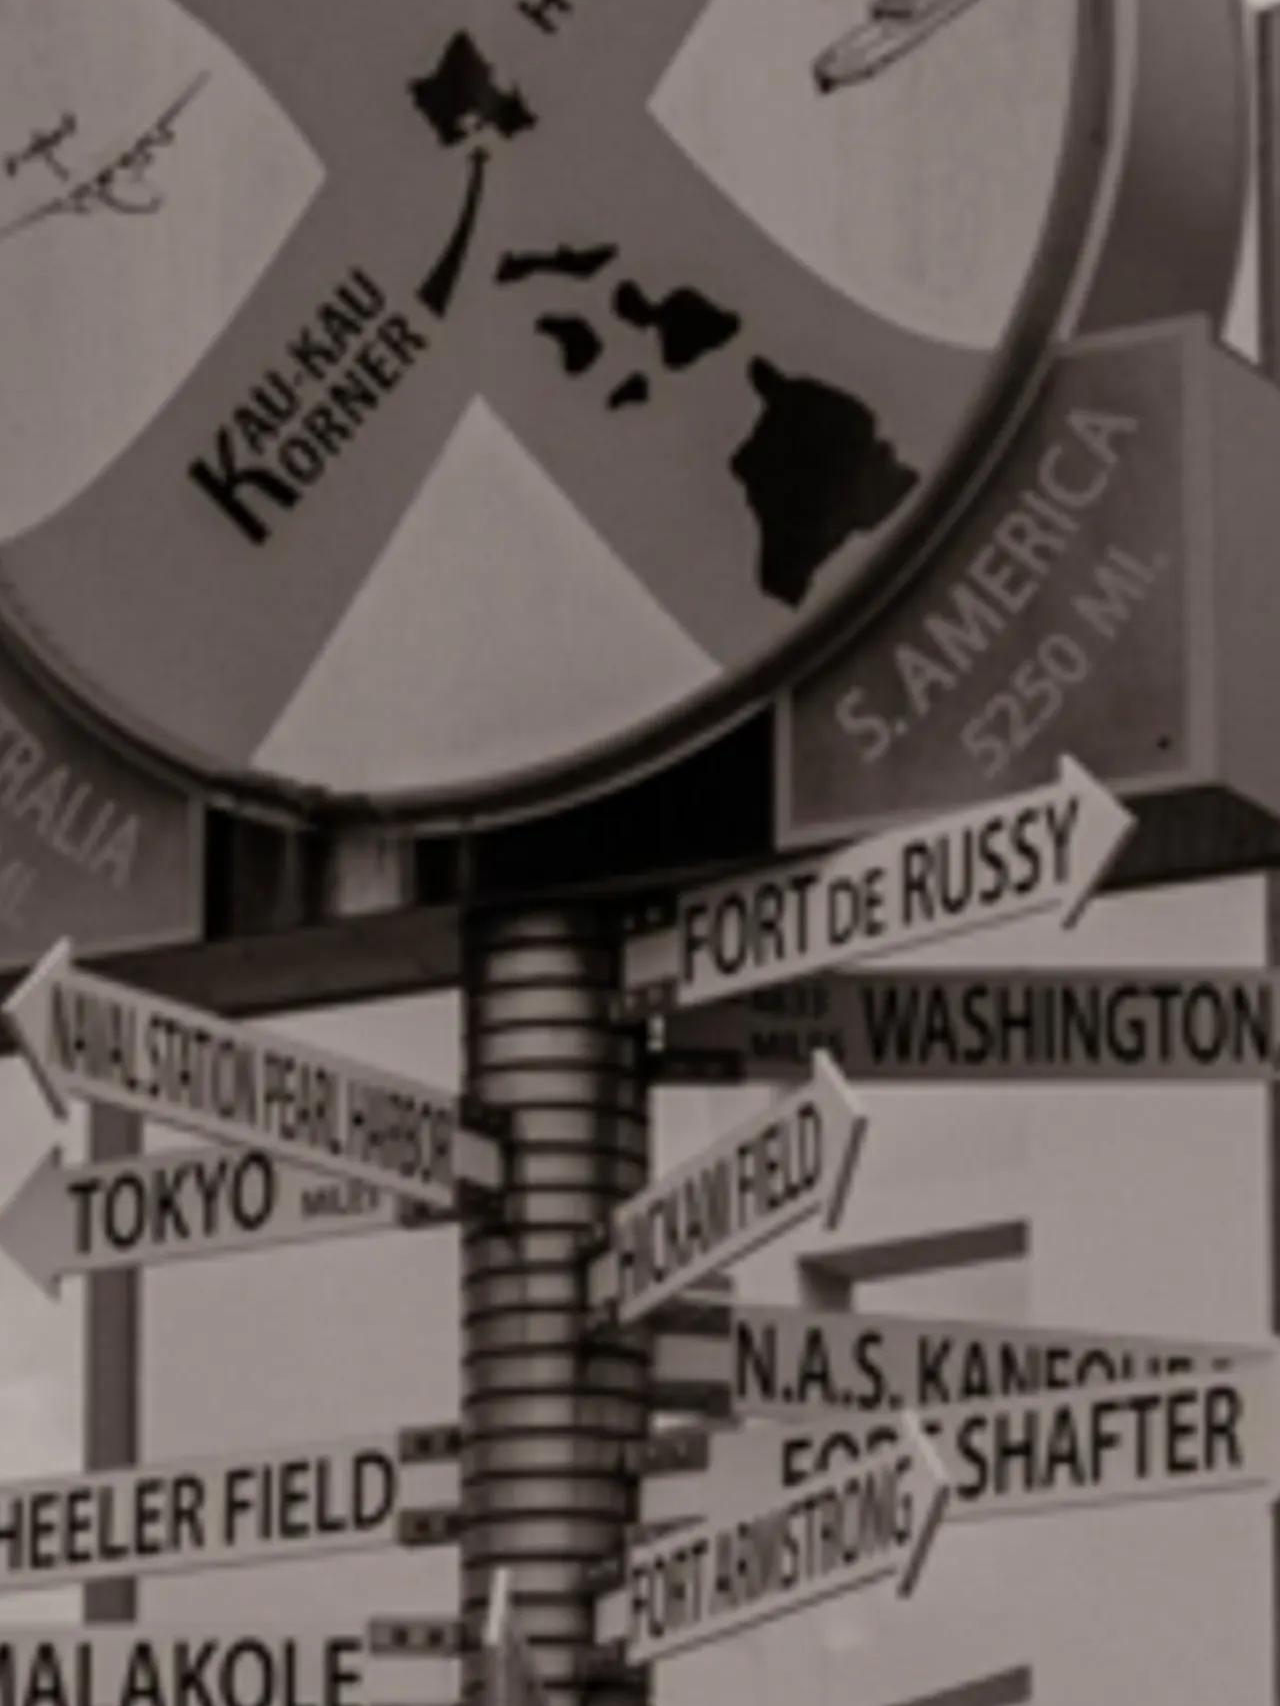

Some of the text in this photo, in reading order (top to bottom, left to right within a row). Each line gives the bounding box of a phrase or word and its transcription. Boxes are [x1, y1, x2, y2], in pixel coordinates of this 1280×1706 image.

[892, 403, 1140, 715] AMERICA
[958, 631, 1091, 780] 5250
[679, 794, 1081, 985] FORT DE RUSSY
[263, 1050, 344, 1157] PEARL
[735, 1100, 823, 1229] FIELD
[66, 1150, 276, 1255] TOKYO
[735, 1324, 902, 1411] N.A.S.
[224, 1450, 400, 1547] FIELD
[954, 1383, 1244, 1499] SHAFTER
[629, 1451, 913, 1641] FORT ARMSTRONG
